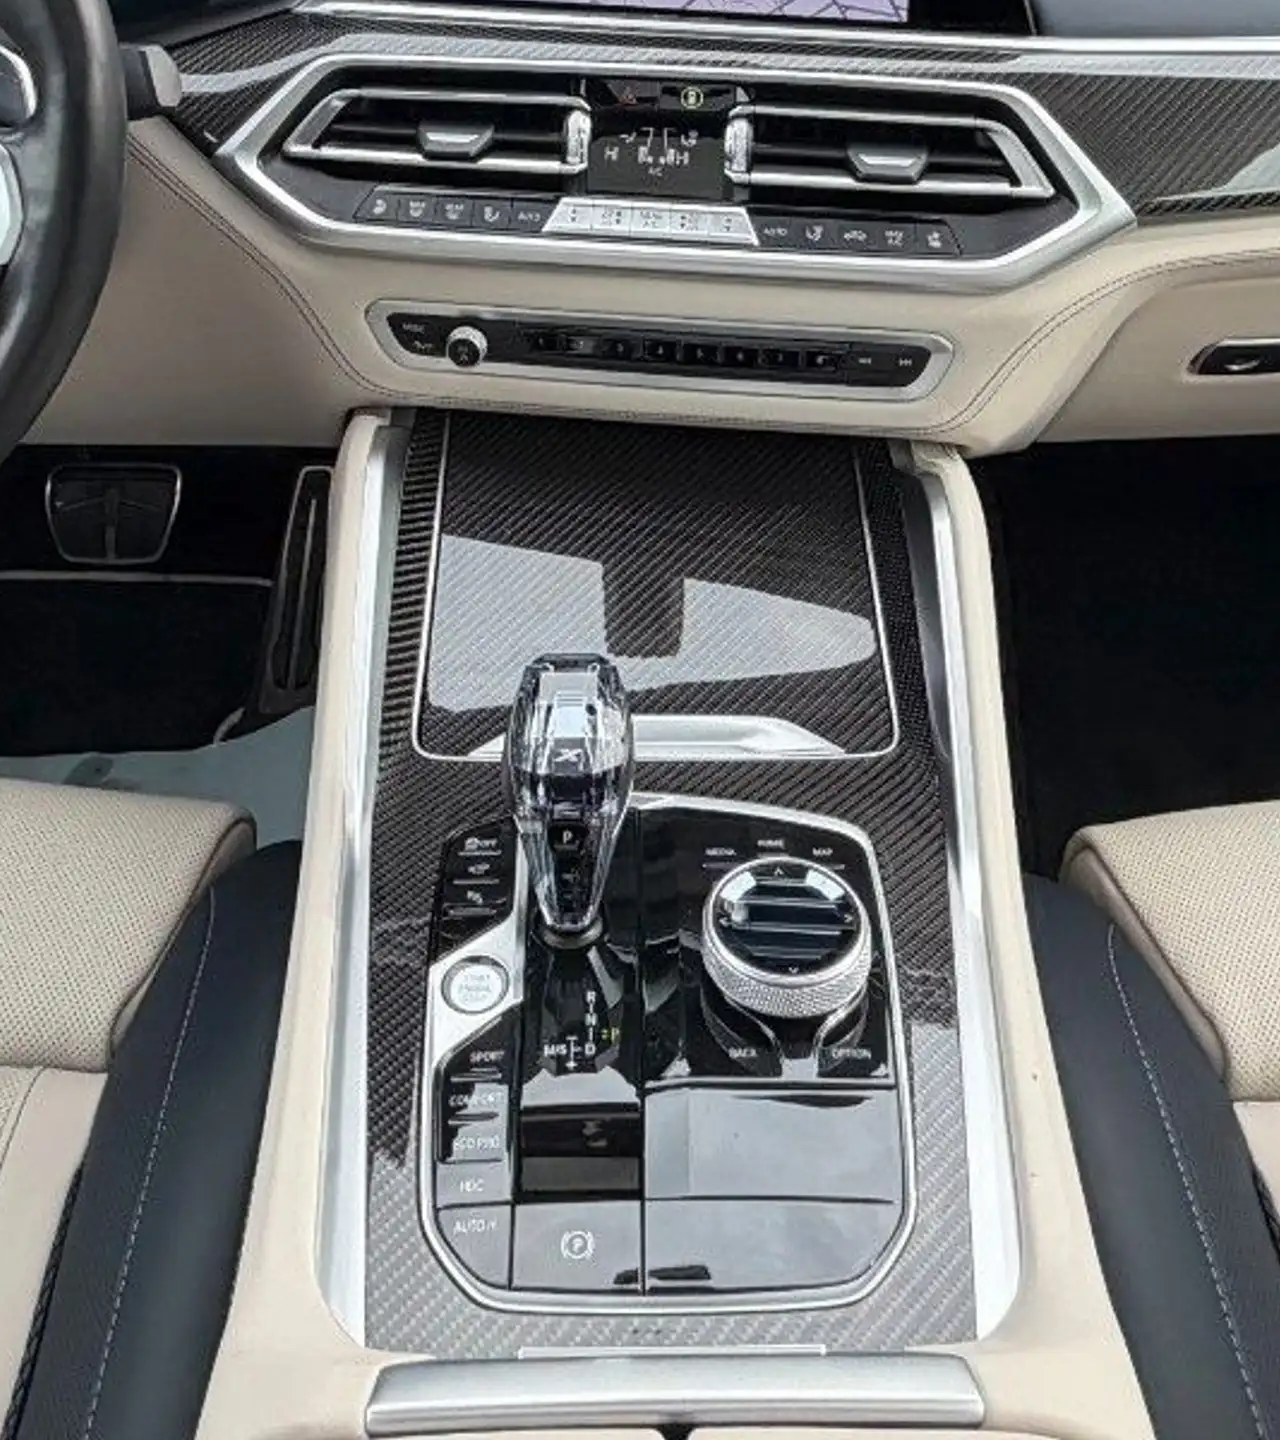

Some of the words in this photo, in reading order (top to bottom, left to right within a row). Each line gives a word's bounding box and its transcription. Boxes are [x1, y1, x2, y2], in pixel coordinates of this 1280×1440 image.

[562, 829, 574, 844] P
[586, 990, 597, 1004] R
[584, 1013, 597, 1027] N
[471, 1051, 505, 1062] SPORT
[584, 1043, 596, 1056] D
[459, 1178, 484, 1192] HDC
